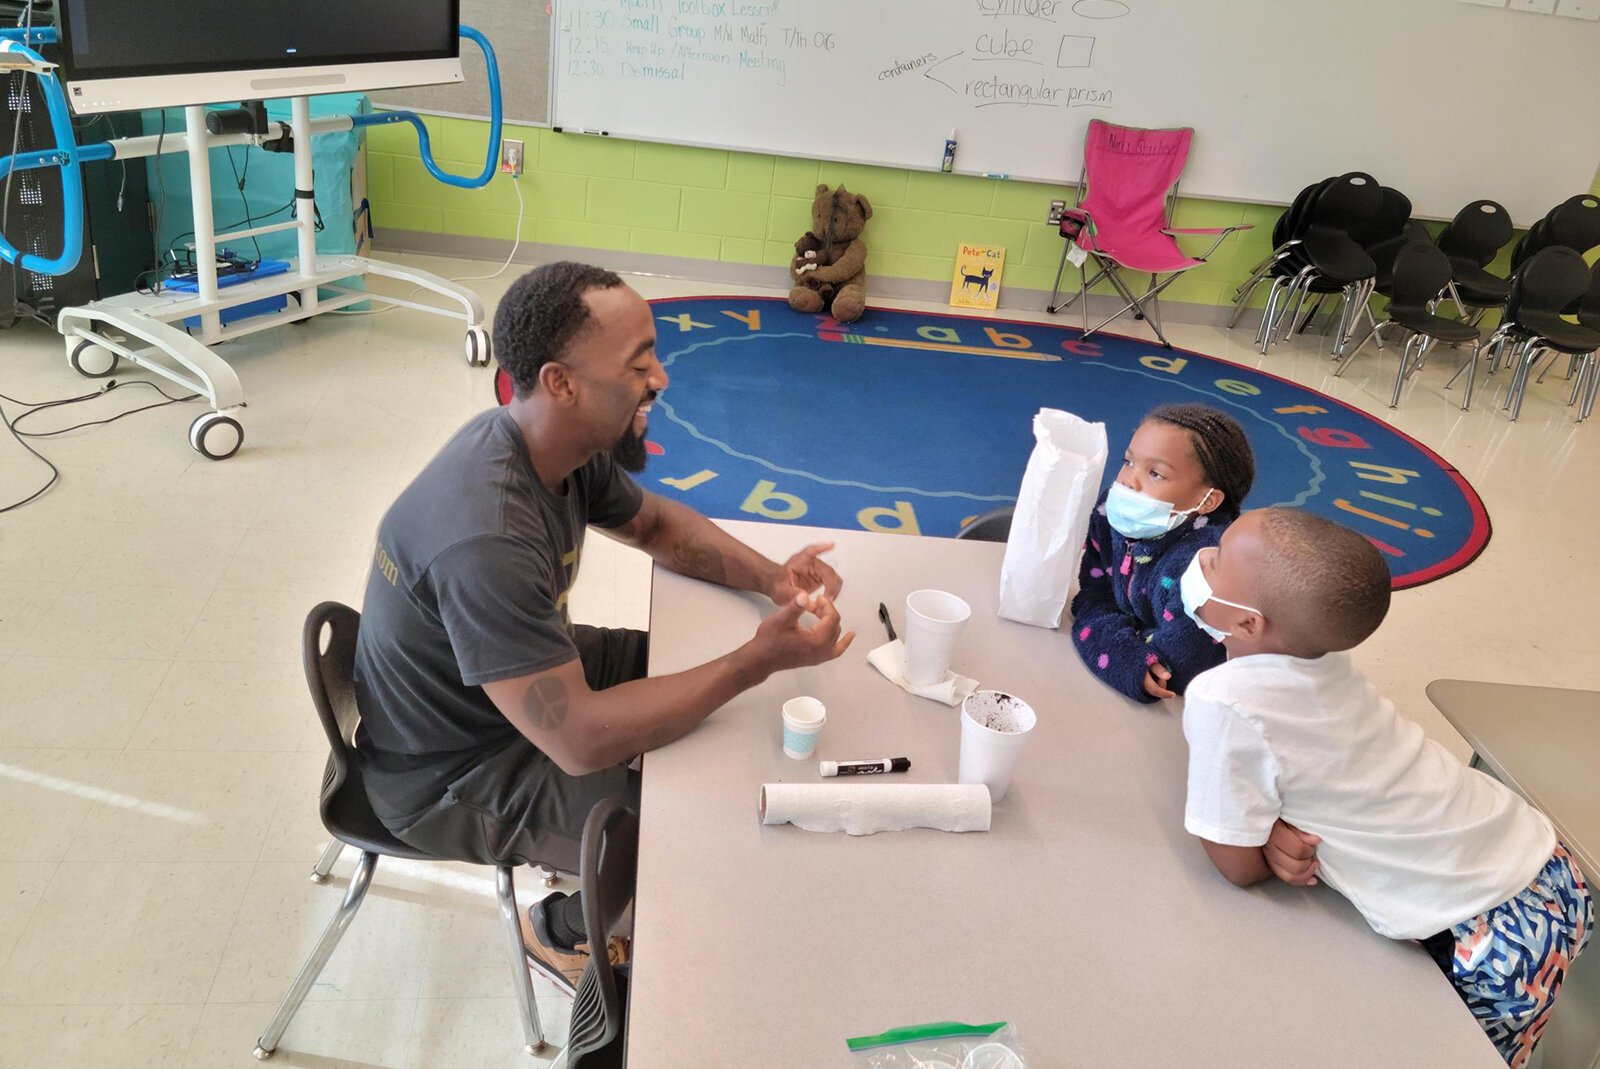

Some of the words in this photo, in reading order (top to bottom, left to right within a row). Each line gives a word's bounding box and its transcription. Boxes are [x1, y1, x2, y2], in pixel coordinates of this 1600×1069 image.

[620, 13, 659, 34] Small
[669, 15, 706, 40] Group
[740, 22, 768, 45] Math
[975, 29, 1033, 57] cube
[878, 52, 938, 81] containers
[965, 76, 1063, 107] rectangular
[1067, 87, 1114, 108] prism
[962, 246, 980, 257] Pete
[986, 249, 1001, 259] Cat
[916, 325, 962, 343] a
[983, 327, 1034, 350] b
[1060, 340, 1104, 357] c
[1214, 378, 1262, 396] e
